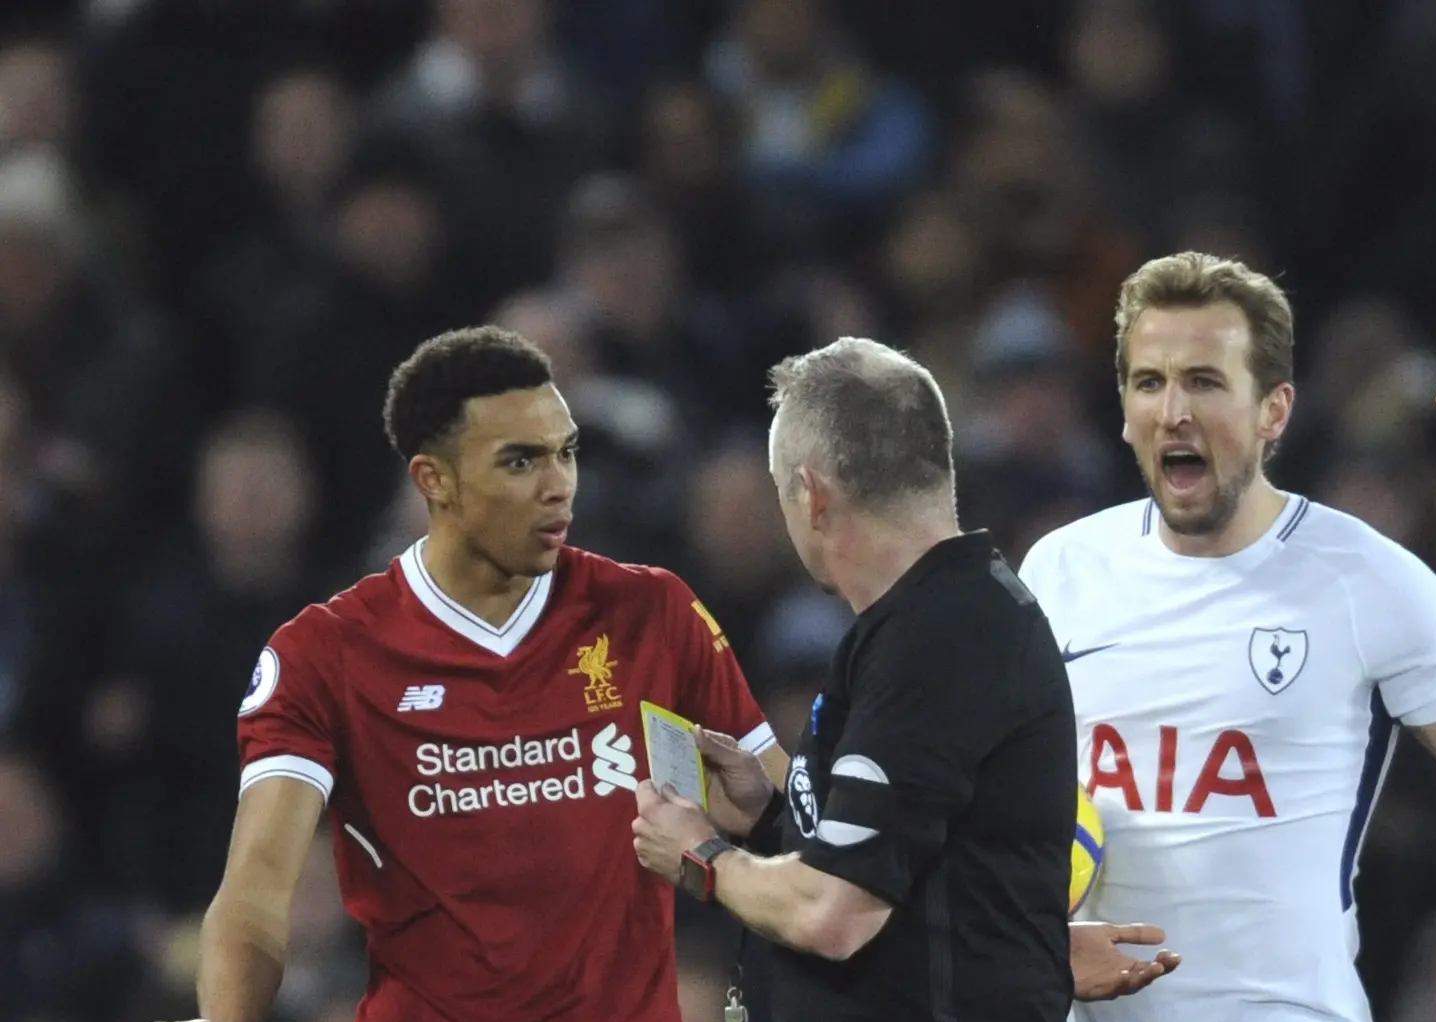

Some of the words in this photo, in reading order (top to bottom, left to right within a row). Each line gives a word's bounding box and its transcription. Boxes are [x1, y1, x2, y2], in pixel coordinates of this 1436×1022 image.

[416, 728, 581, 776] Standard
[1087, 723, 1277, 819] AIA
[408, 766, 585, 818] Chartered
